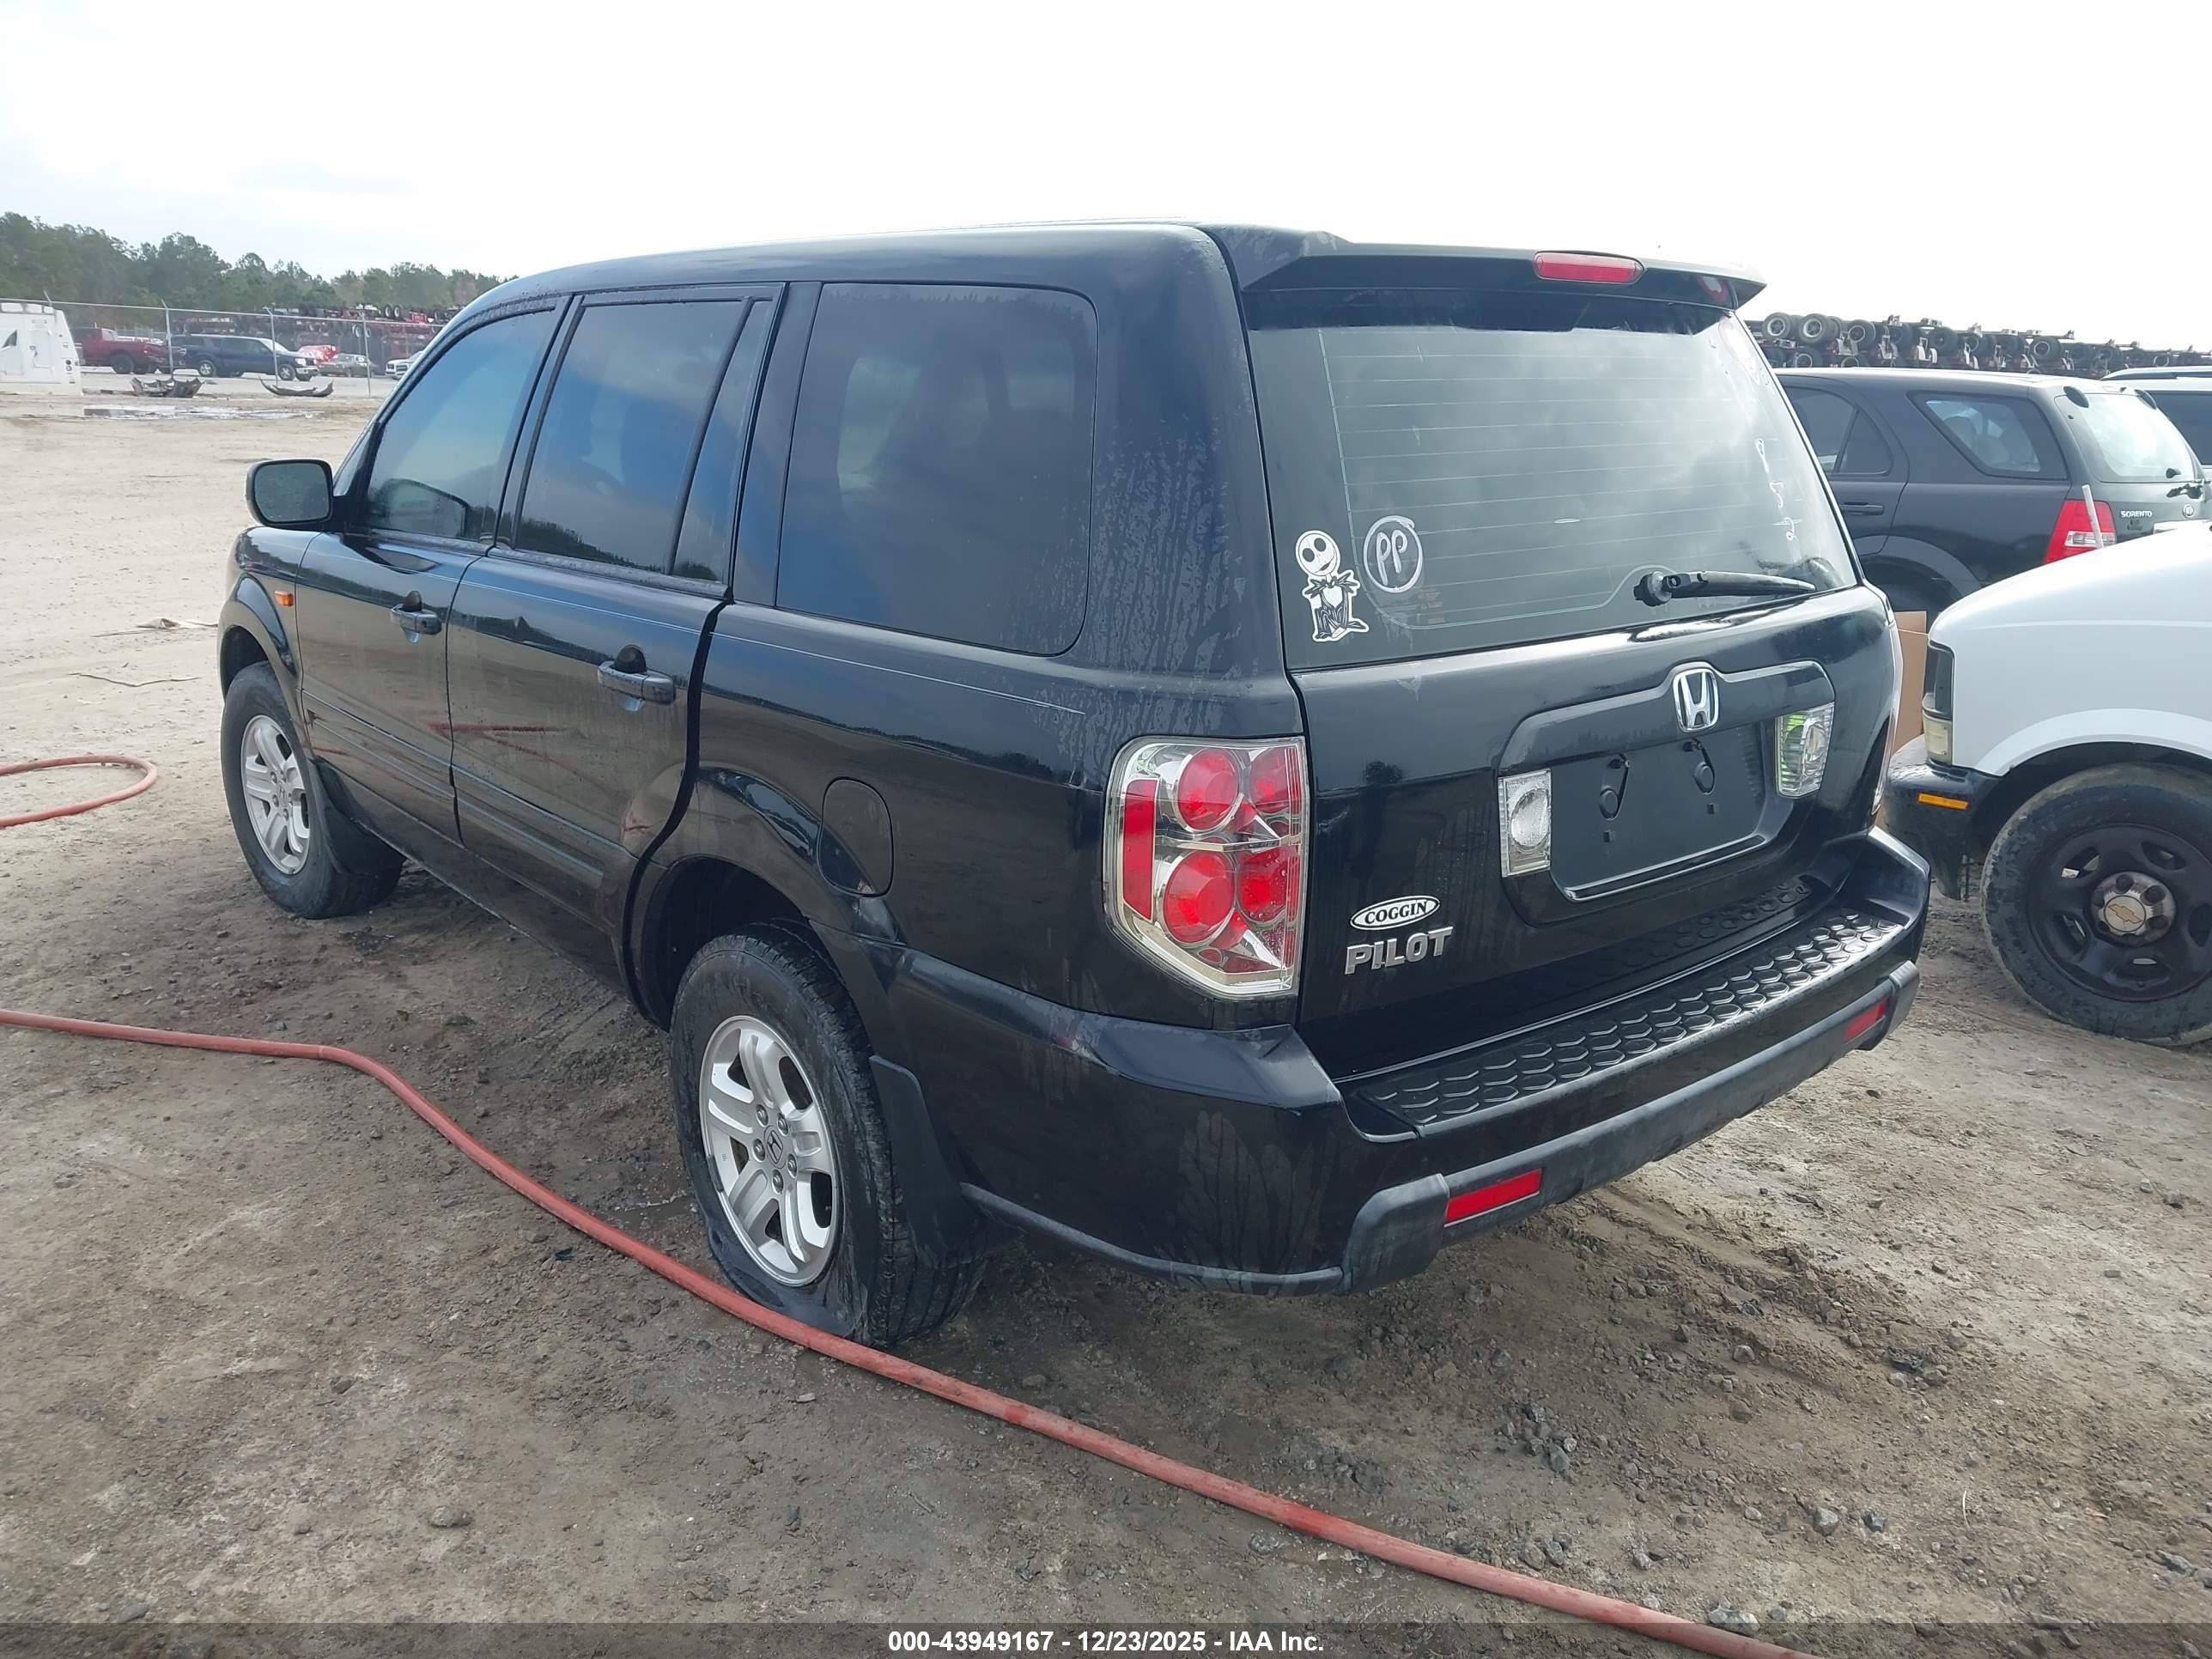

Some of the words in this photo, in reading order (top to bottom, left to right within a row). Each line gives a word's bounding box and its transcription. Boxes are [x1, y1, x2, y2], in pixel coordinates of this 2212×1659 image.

[2120, 510, 2153, 519] SORENTO
[1364, 902, 1428, 925] COGGIN
[1344, 926, 1454, 975] PILOT
